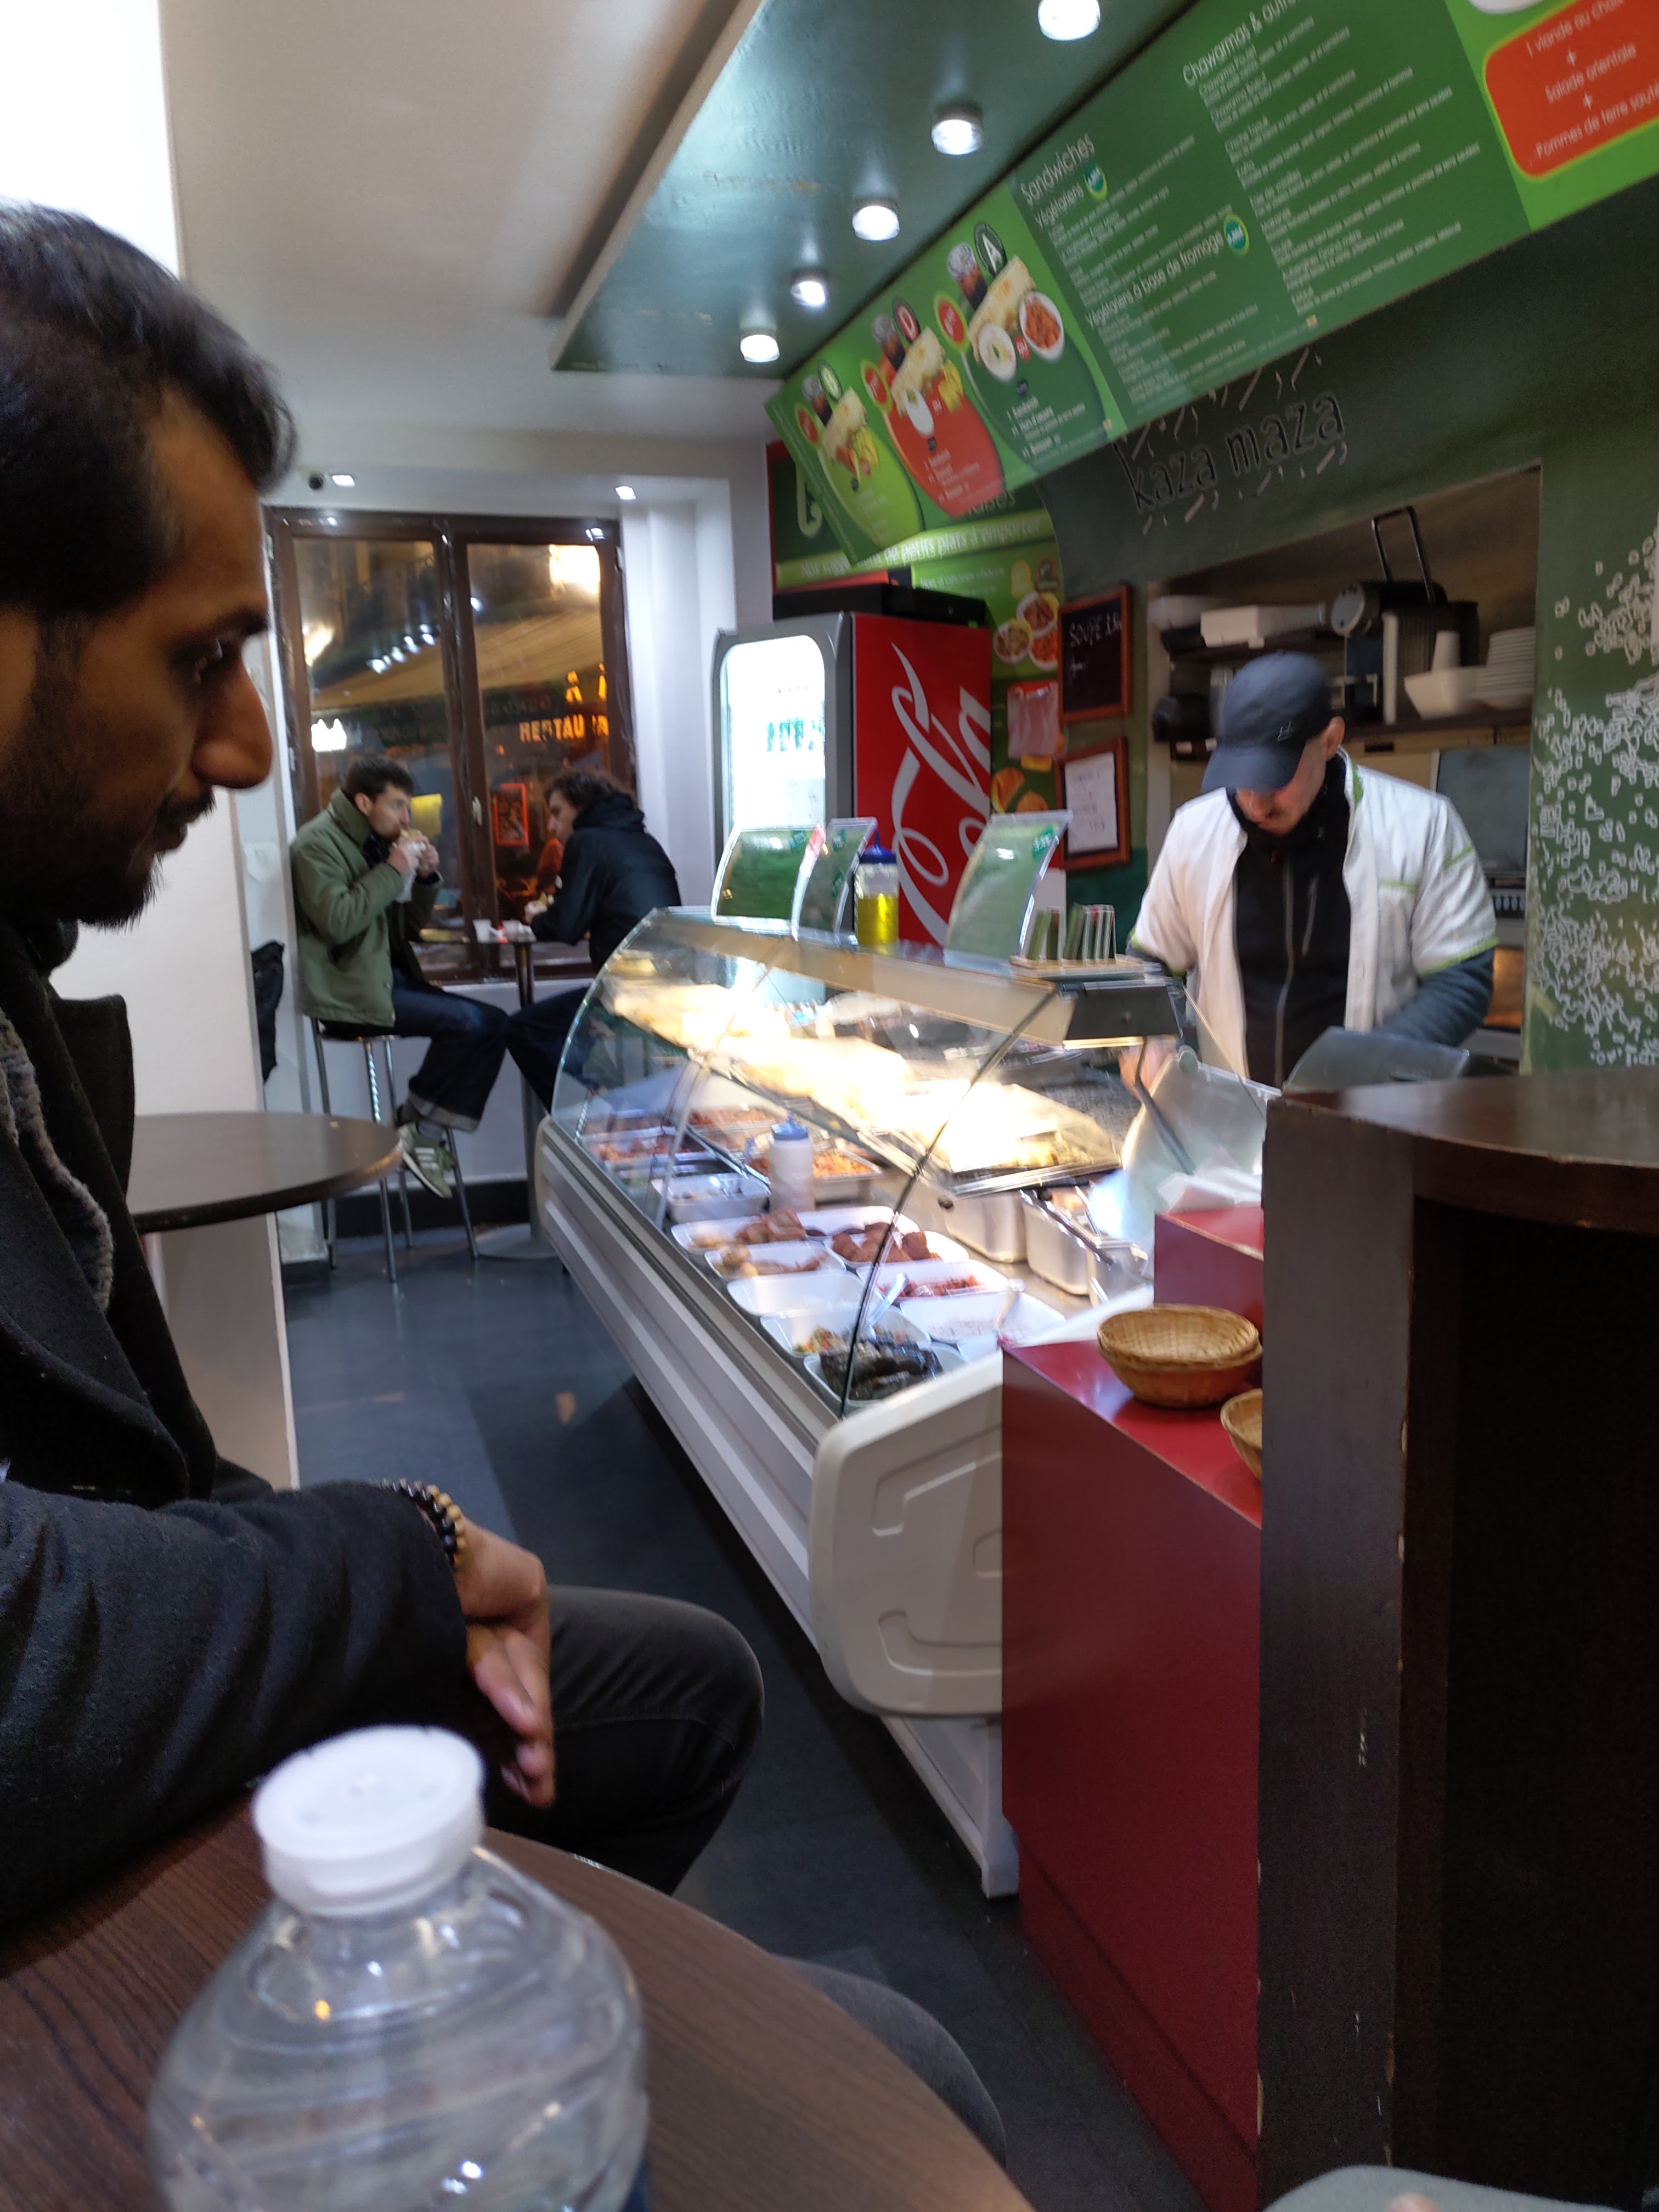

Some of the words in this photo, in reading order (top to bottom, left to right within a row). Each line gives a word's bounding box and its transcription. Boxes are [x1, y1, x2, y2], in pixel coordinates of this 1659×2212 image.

[1545, 71, 1584, 104] Salade
[1586, 42, 1637, 81] orientale
[1020, 133, 1096, 210] Sandwiches
[1536, 124, 1584, 160] Pommes
[1226, 393, 1345, 478] maza
